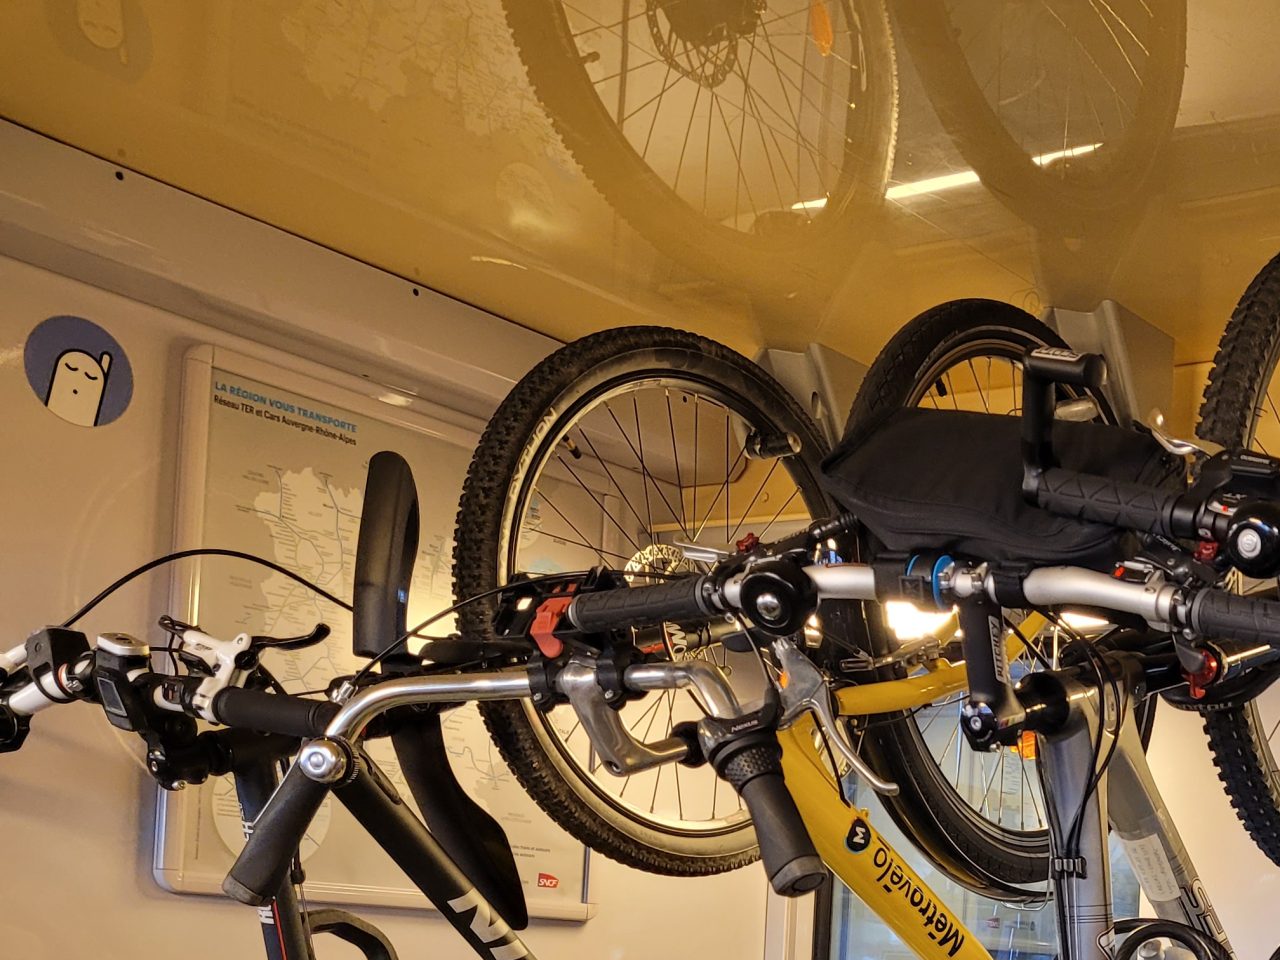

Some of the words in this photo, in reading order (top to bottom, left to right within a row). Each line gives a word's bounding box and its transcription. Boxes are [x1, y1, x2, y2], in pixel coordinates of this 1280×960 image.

[214, 394, 239, 410] Réseau
[240, 403, 255, 415] TER
[255, 409, 263, 417] et
[264, 410, 281, 423] Cars
[281, 416, 357, 446] Auvergne-Rhône-Alpes
[215, 382, 227, 393] LA
[229, 385, 267, 405] RÉGION
[269, 398, 296, 414] VOUS
[297, 407, 357, 433] TRANSPORTE
[731, 719, 759, 733] Nexus
